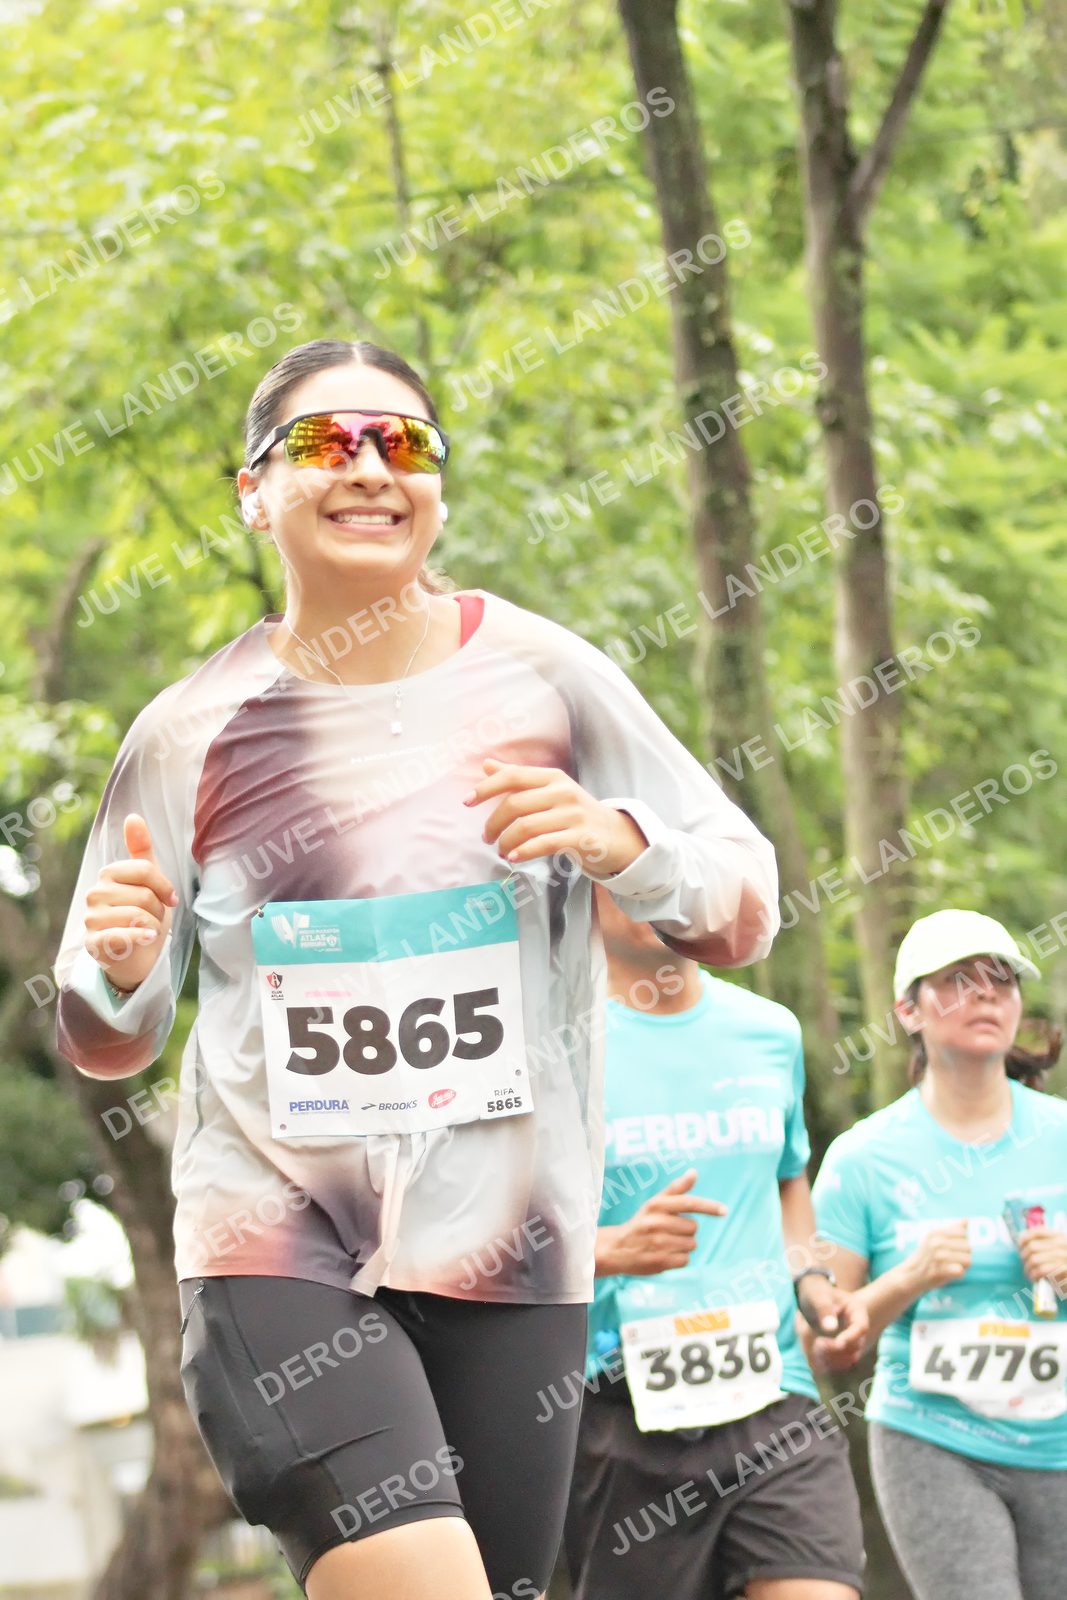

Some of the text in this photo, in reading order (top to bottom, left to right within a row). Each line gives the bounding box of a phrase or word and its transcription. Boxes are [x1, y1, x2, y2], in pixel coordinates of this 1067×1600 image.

[286, 987, 504, 1075] 5865
[494, 1087, 514, 1097] RIFA
[289, 1099, 350, 1112] PERDURA
[378, 1100, 417, 1111] BROOKS
[487, 1096, 523, 1113] 5865
[640, 1333, 771, 1391] 3836
[924, 1344, 1059, 1382] 4776
